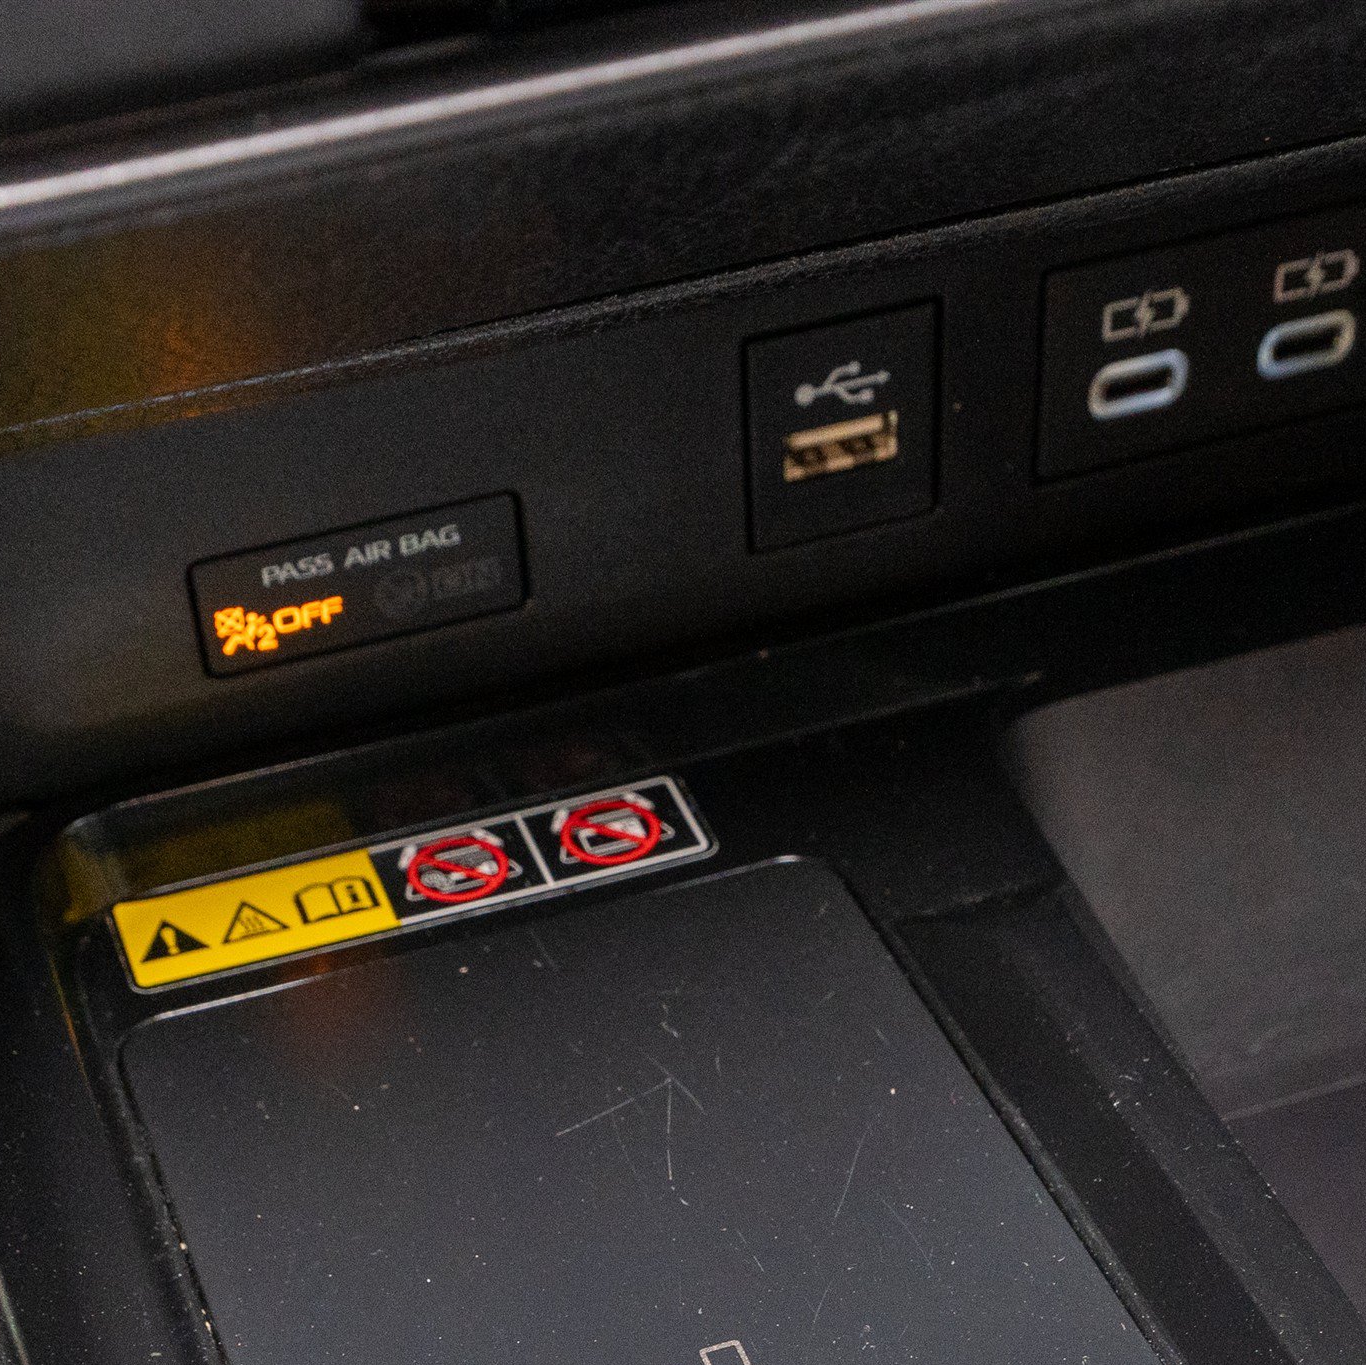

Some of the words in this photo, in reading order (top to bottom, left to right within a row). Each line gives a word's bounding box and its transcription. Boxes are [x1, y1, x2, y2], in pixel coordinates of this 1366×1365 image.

[261, 553, 334, 587] PASS
[344, 540, 392, 569] AIR
[399, 524, 462, 557] BAG
[272, 595, 344, 634] OFF
